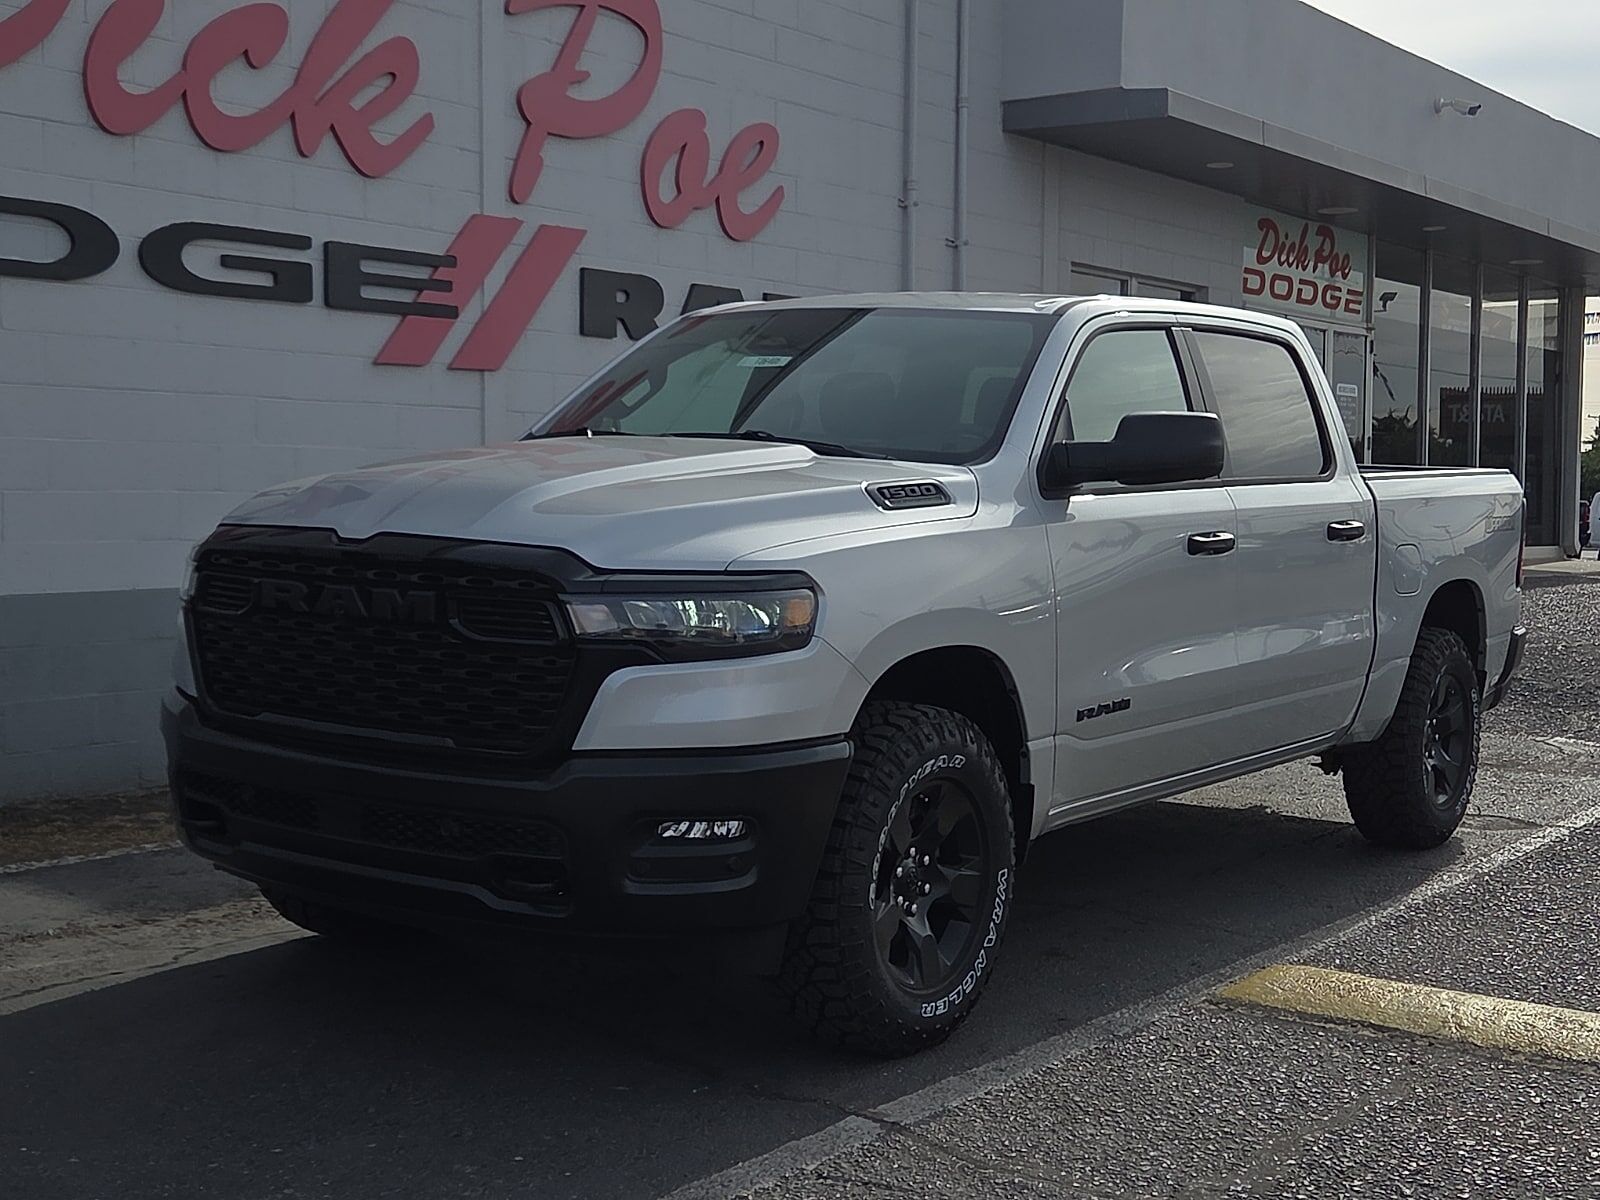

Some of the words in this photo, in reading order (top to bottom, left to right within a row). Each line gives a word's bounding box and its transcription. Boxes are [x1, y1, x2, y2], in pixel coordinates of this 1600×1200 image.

[0, 0, 435, 179] ick
[505, 0, 785, 242] Poe
[1256, 217, 1311, 272] Dick
[1312, 225, 1352, 280] Poe
[1242, 266, 1364, 315] DODGE
[881, 484, 938, 499] 1500
[256, 578, 436, 624] RAM
[1076, 697, 1131, 722] RAM
[920, 868, 1008, 1019] WRANGLER
